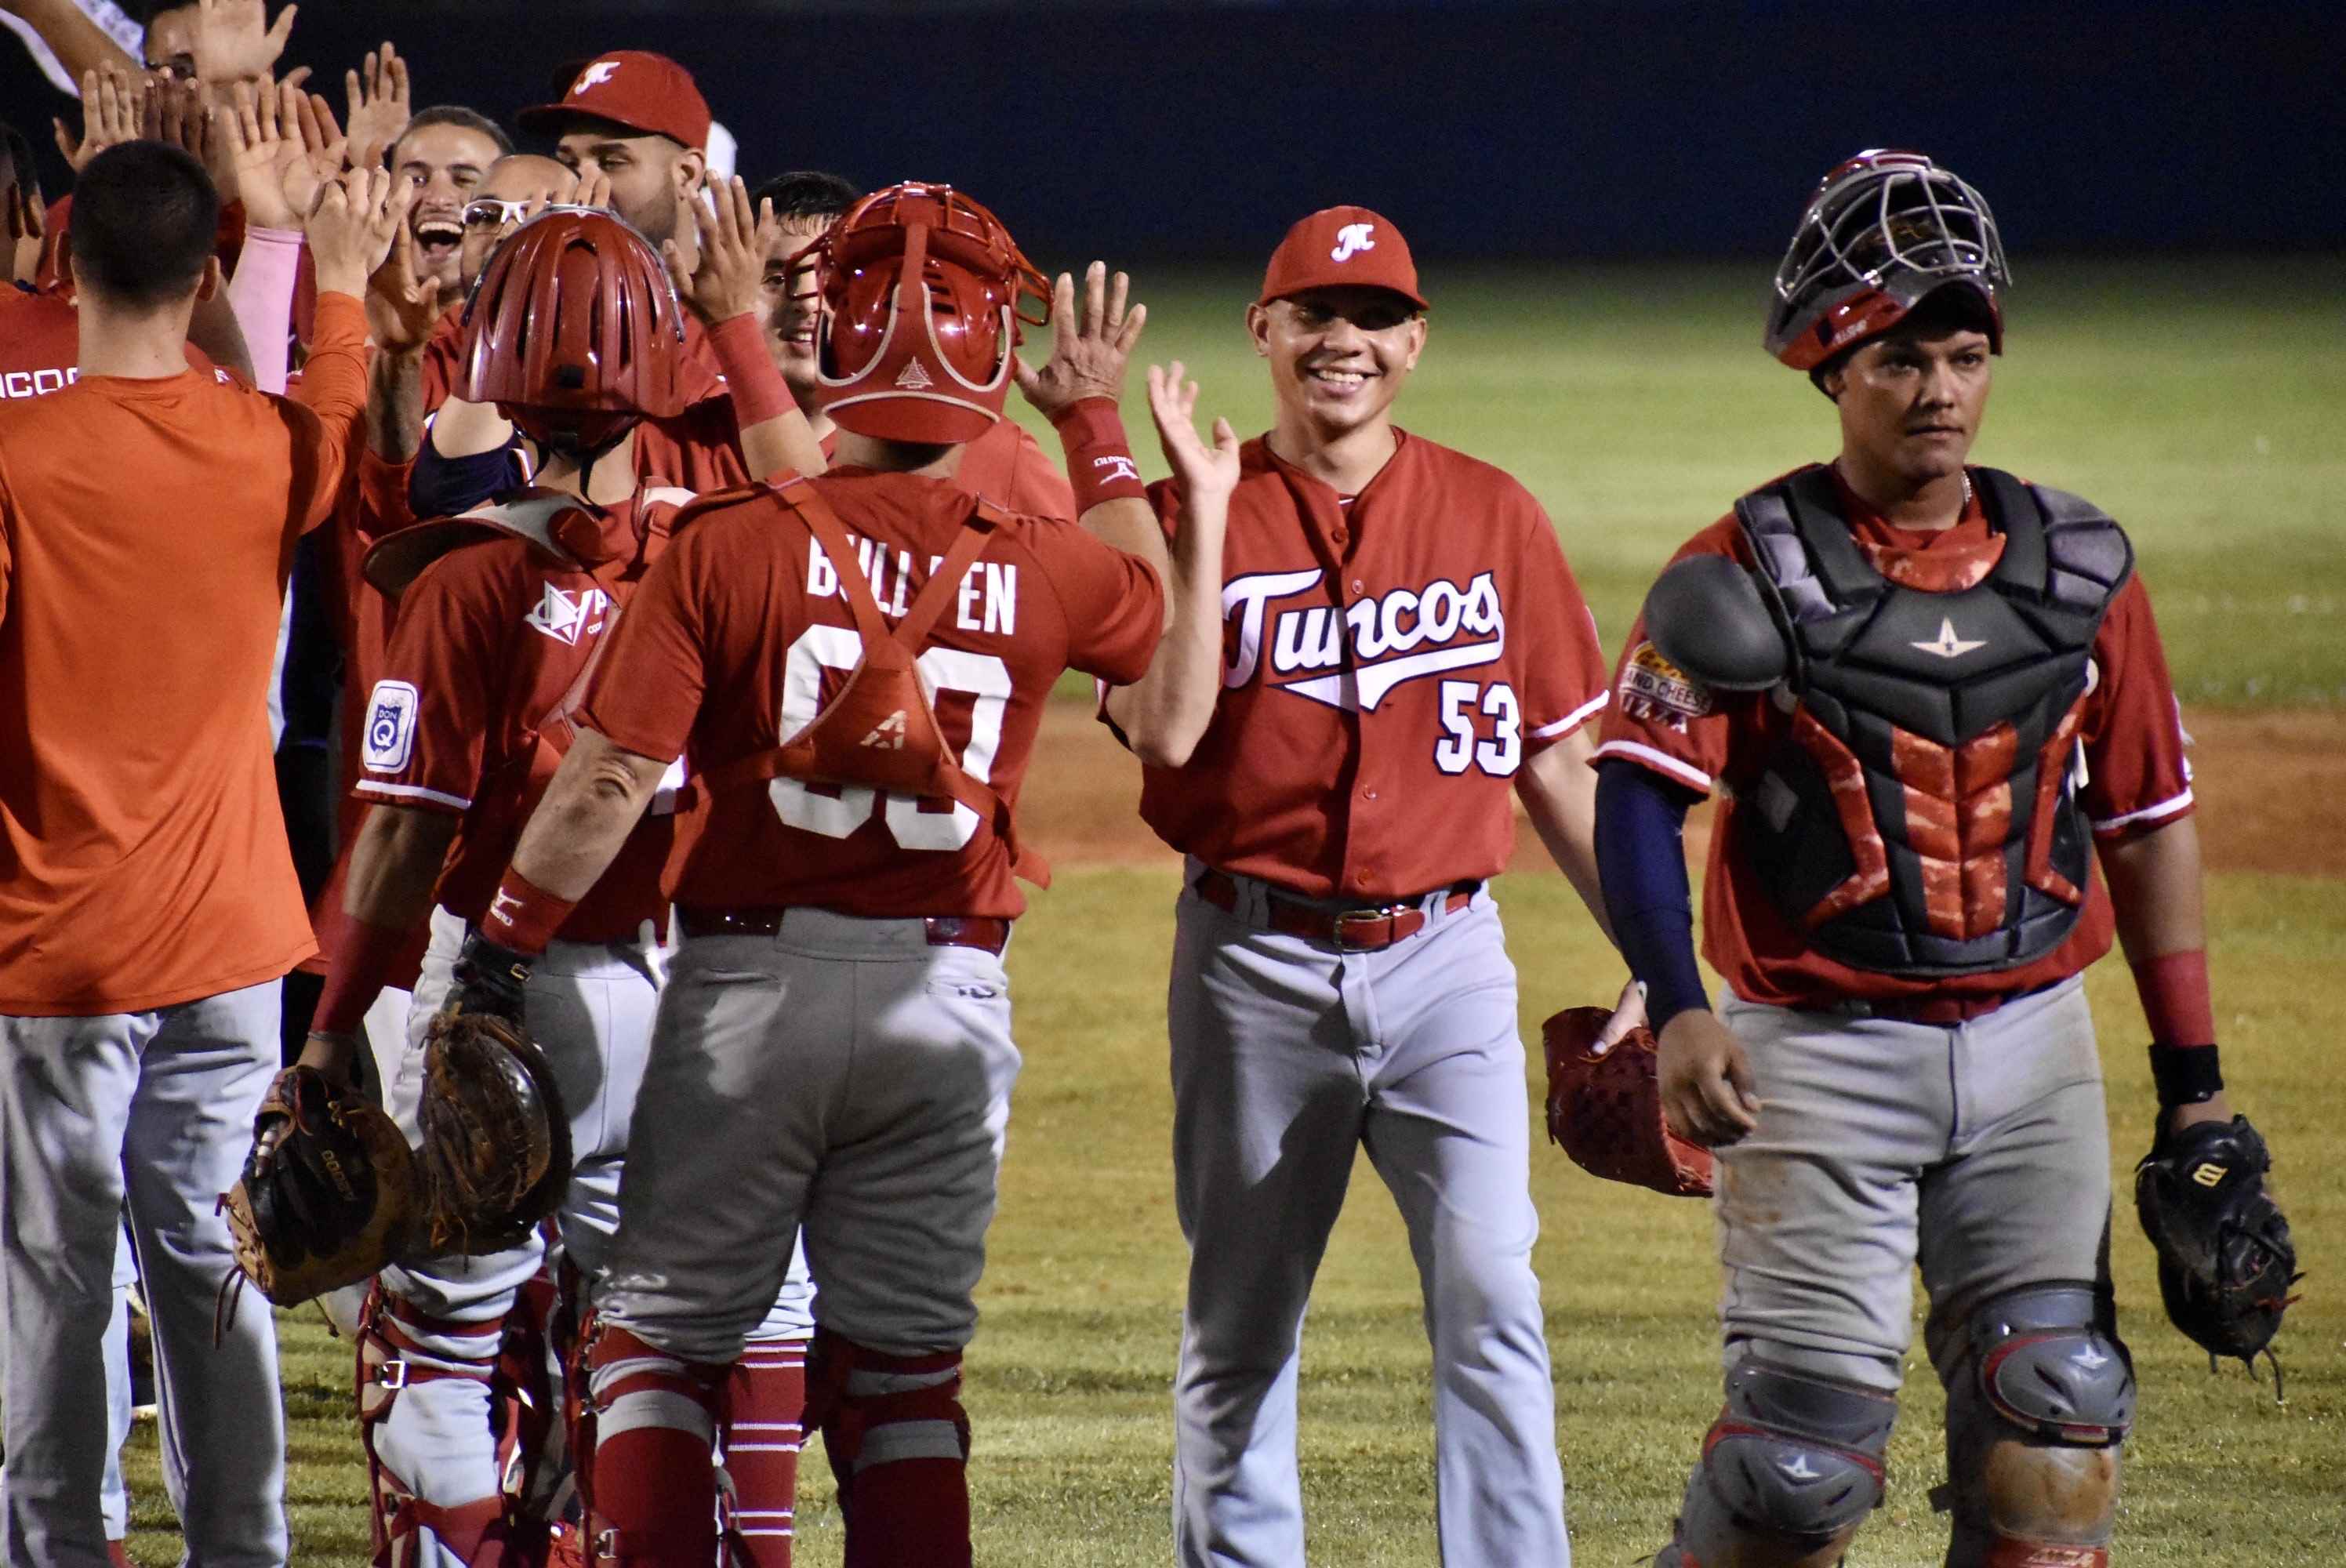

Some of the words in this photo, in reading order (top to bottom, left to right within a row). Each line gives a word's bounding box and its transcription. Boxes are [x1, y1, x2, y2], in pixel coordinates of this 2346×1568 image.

[379, 710, 397, 720] DON
[1433, 679, 1521, 777] 53
[373, 719, 395, 747] Q
